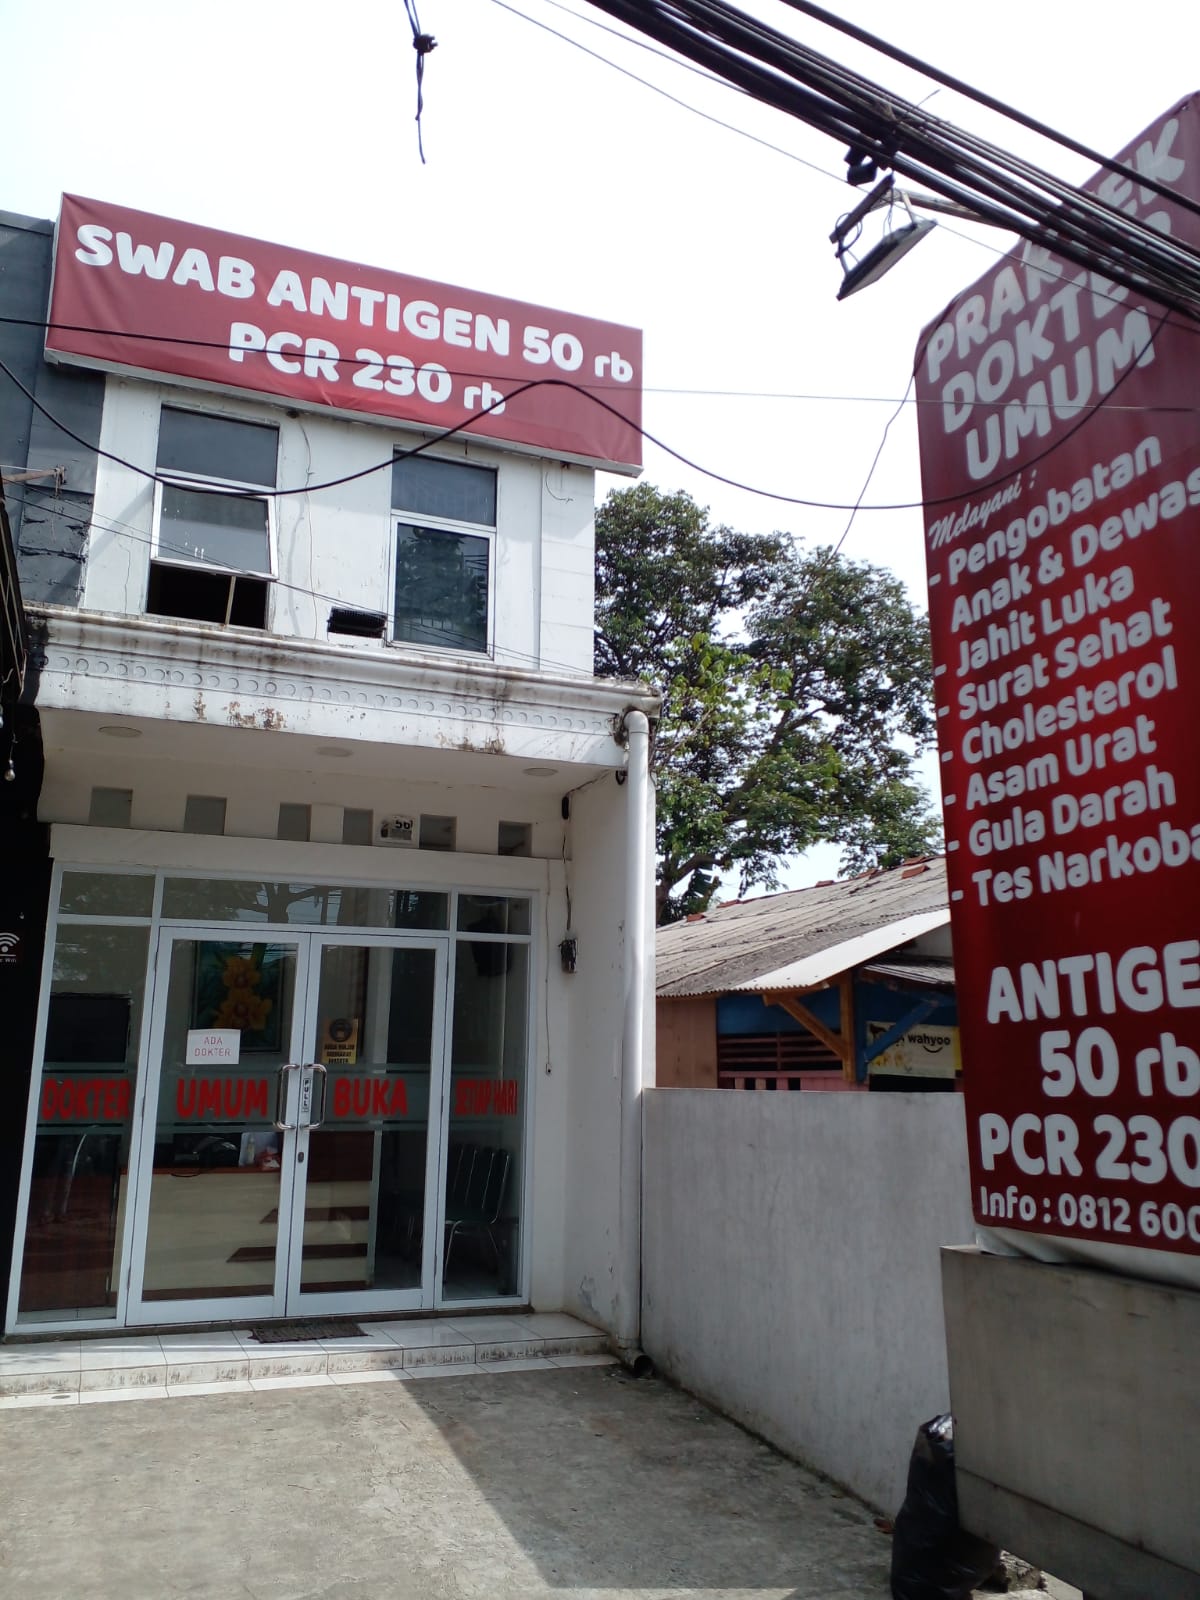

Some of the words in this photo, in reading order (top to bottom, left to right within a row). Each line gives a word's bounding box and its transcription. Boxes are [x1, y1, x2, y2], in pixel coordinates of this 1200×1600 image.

[926, 118, 1186, 384] PRAKEK
[75, 224, 256, 299] SWAB
[267, 270, 510, 356] ANTIGEN
[523, 329, 583, 371] 50
[594, 350, 634, 384] rb
[229, 322, 340, 382] PCR
[352, 349, 453, 403] 230
[463, 382, 506, 416] rb
[965, 306, 1156, 480] UMUM
[949, 435, 1162, 585] Pengobatan
[951, 563, 1032, 632] Anak
[1037, 546, 1065, 585] &
[957, 613, 1036, 677] Jahit
[1042, 564, 1135, 635] Luka
[959, 652, 1050, 720] Surat
[1054, 598, 1173, 679] Sehat
[962, 645, 1178, 765] Cholesterol
[966, 751, 1060, 811] Asam
[1066, 714, 1157, 777] Urat
[968, 806, 1045, 857] Gula
[1052, 764, 1176, 836] Darah
[972, 865, 1031, 907] Tes
[987, 939, 1200, 1025] ANTIGE
[194, 1047, 231, 1057] DOKTER
[203, 1036, 223, 1045] ADA
[907, 1033, 952, 1047] wahyoo
[1040, 1026, 1120, 1098] 50
[1135, 1032, 1200, 1097] rb
[42, 1078, 131, 1120] DOKTER
[175, 1077, 269, 1119] UMUM
[332, 1077, 409, 1118] BUKA
[979, 1112, 1083, 1177] PCR
[1093, 1114, 1200, 1188] 230
[980, 1185, 1037, 1221] Info
[1058, 1193, 1132, 1233] 0812
